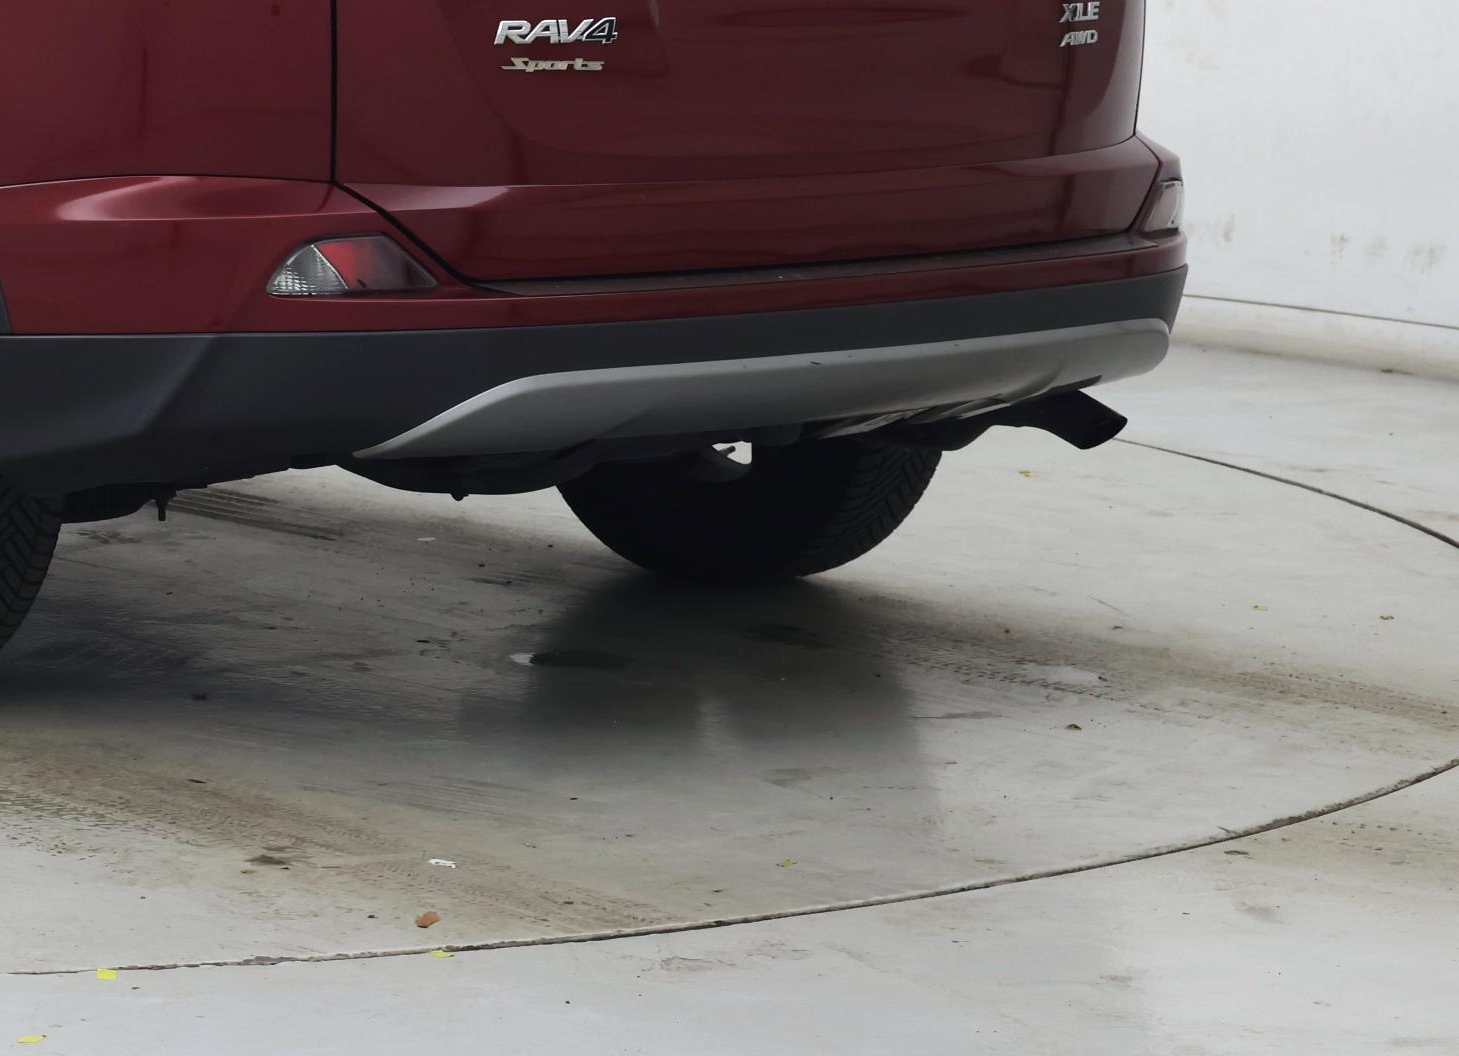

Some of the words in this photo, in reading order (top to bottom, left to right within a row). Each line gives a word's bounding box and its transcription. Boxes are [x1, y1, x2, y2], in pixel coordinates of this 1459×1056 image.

[1059, 1, 1100, 23] XLE
[493, 16, 618, 45] RAV4
[1060, 29, 1099, 47] AWD
[500, 57, 605, 72] Sports
